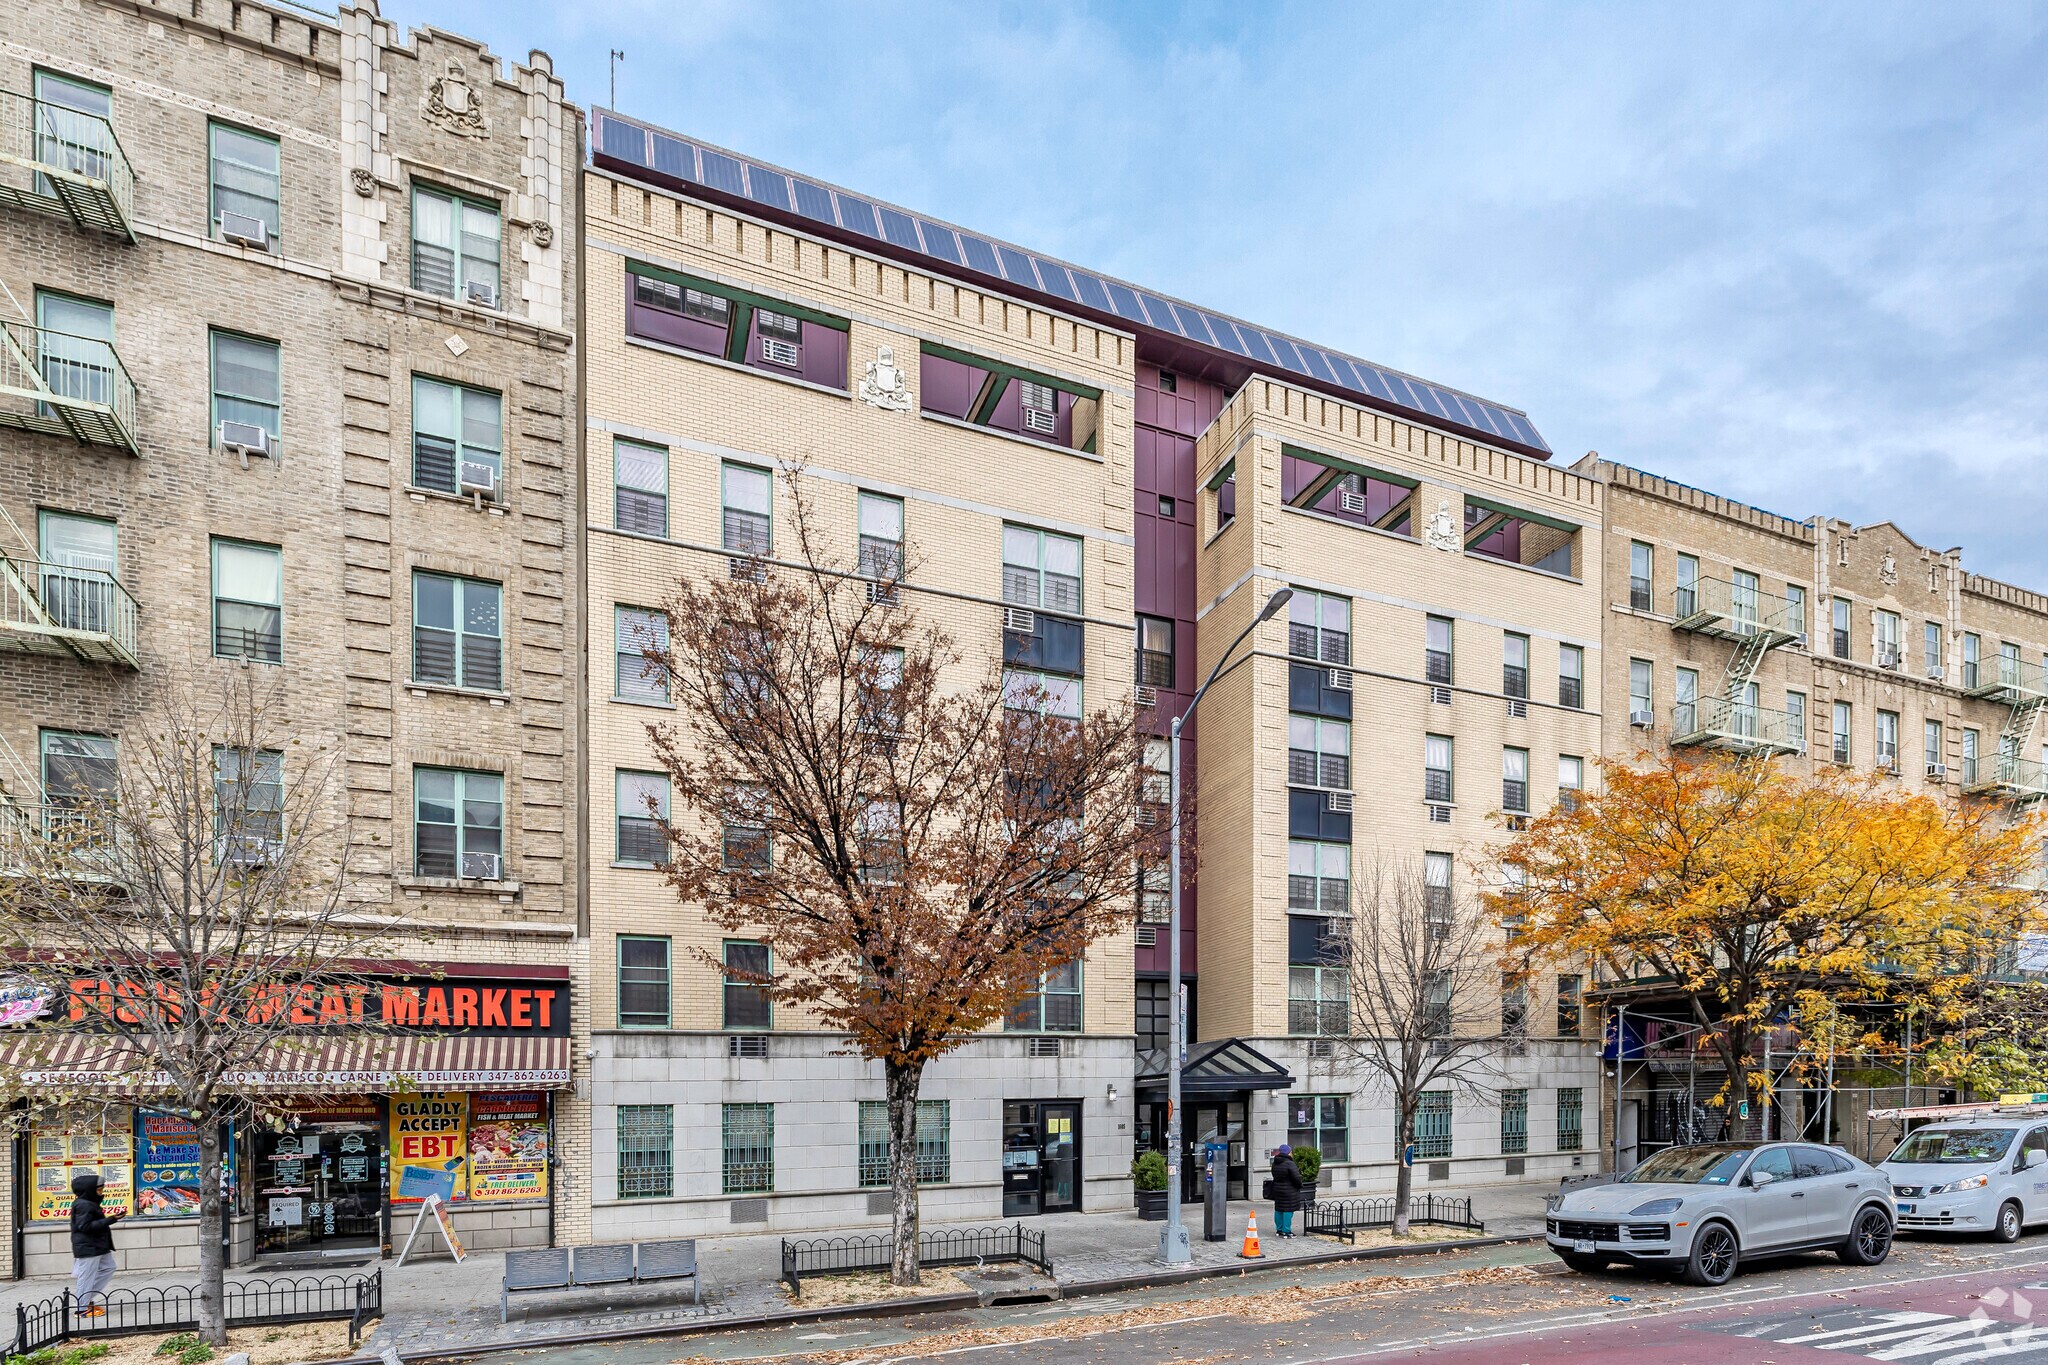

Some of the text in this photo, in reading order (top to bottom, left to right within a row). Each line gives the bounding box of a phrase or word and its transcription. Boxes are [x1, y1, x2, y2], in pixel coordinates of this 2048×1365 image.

[246, 984, 369, 1025] MEAT
[382, 986, 556, 1027] MARKET
[340, 1073, 381, 1082] CARNE
[427, 1072, 484, 1082] DELIVERY
[488, 1071, 568, 1081] 347-862-6263
[397, 1103, 461, 1116] GLADLY
[514, 1112, 539, 1120] MARKET
[152, 1124, 188, 1133] Marisco
[399, 1119, 460, 1132] ACCEPT
[163, 1146, 187, 1154] Make
[402, 1136, 459, 1159] EBT
[149, 1154, 167, 1163] Fish
[169, 1154, 186, 1162] and
[507, 1180, 539, 1188] DELIVERY
